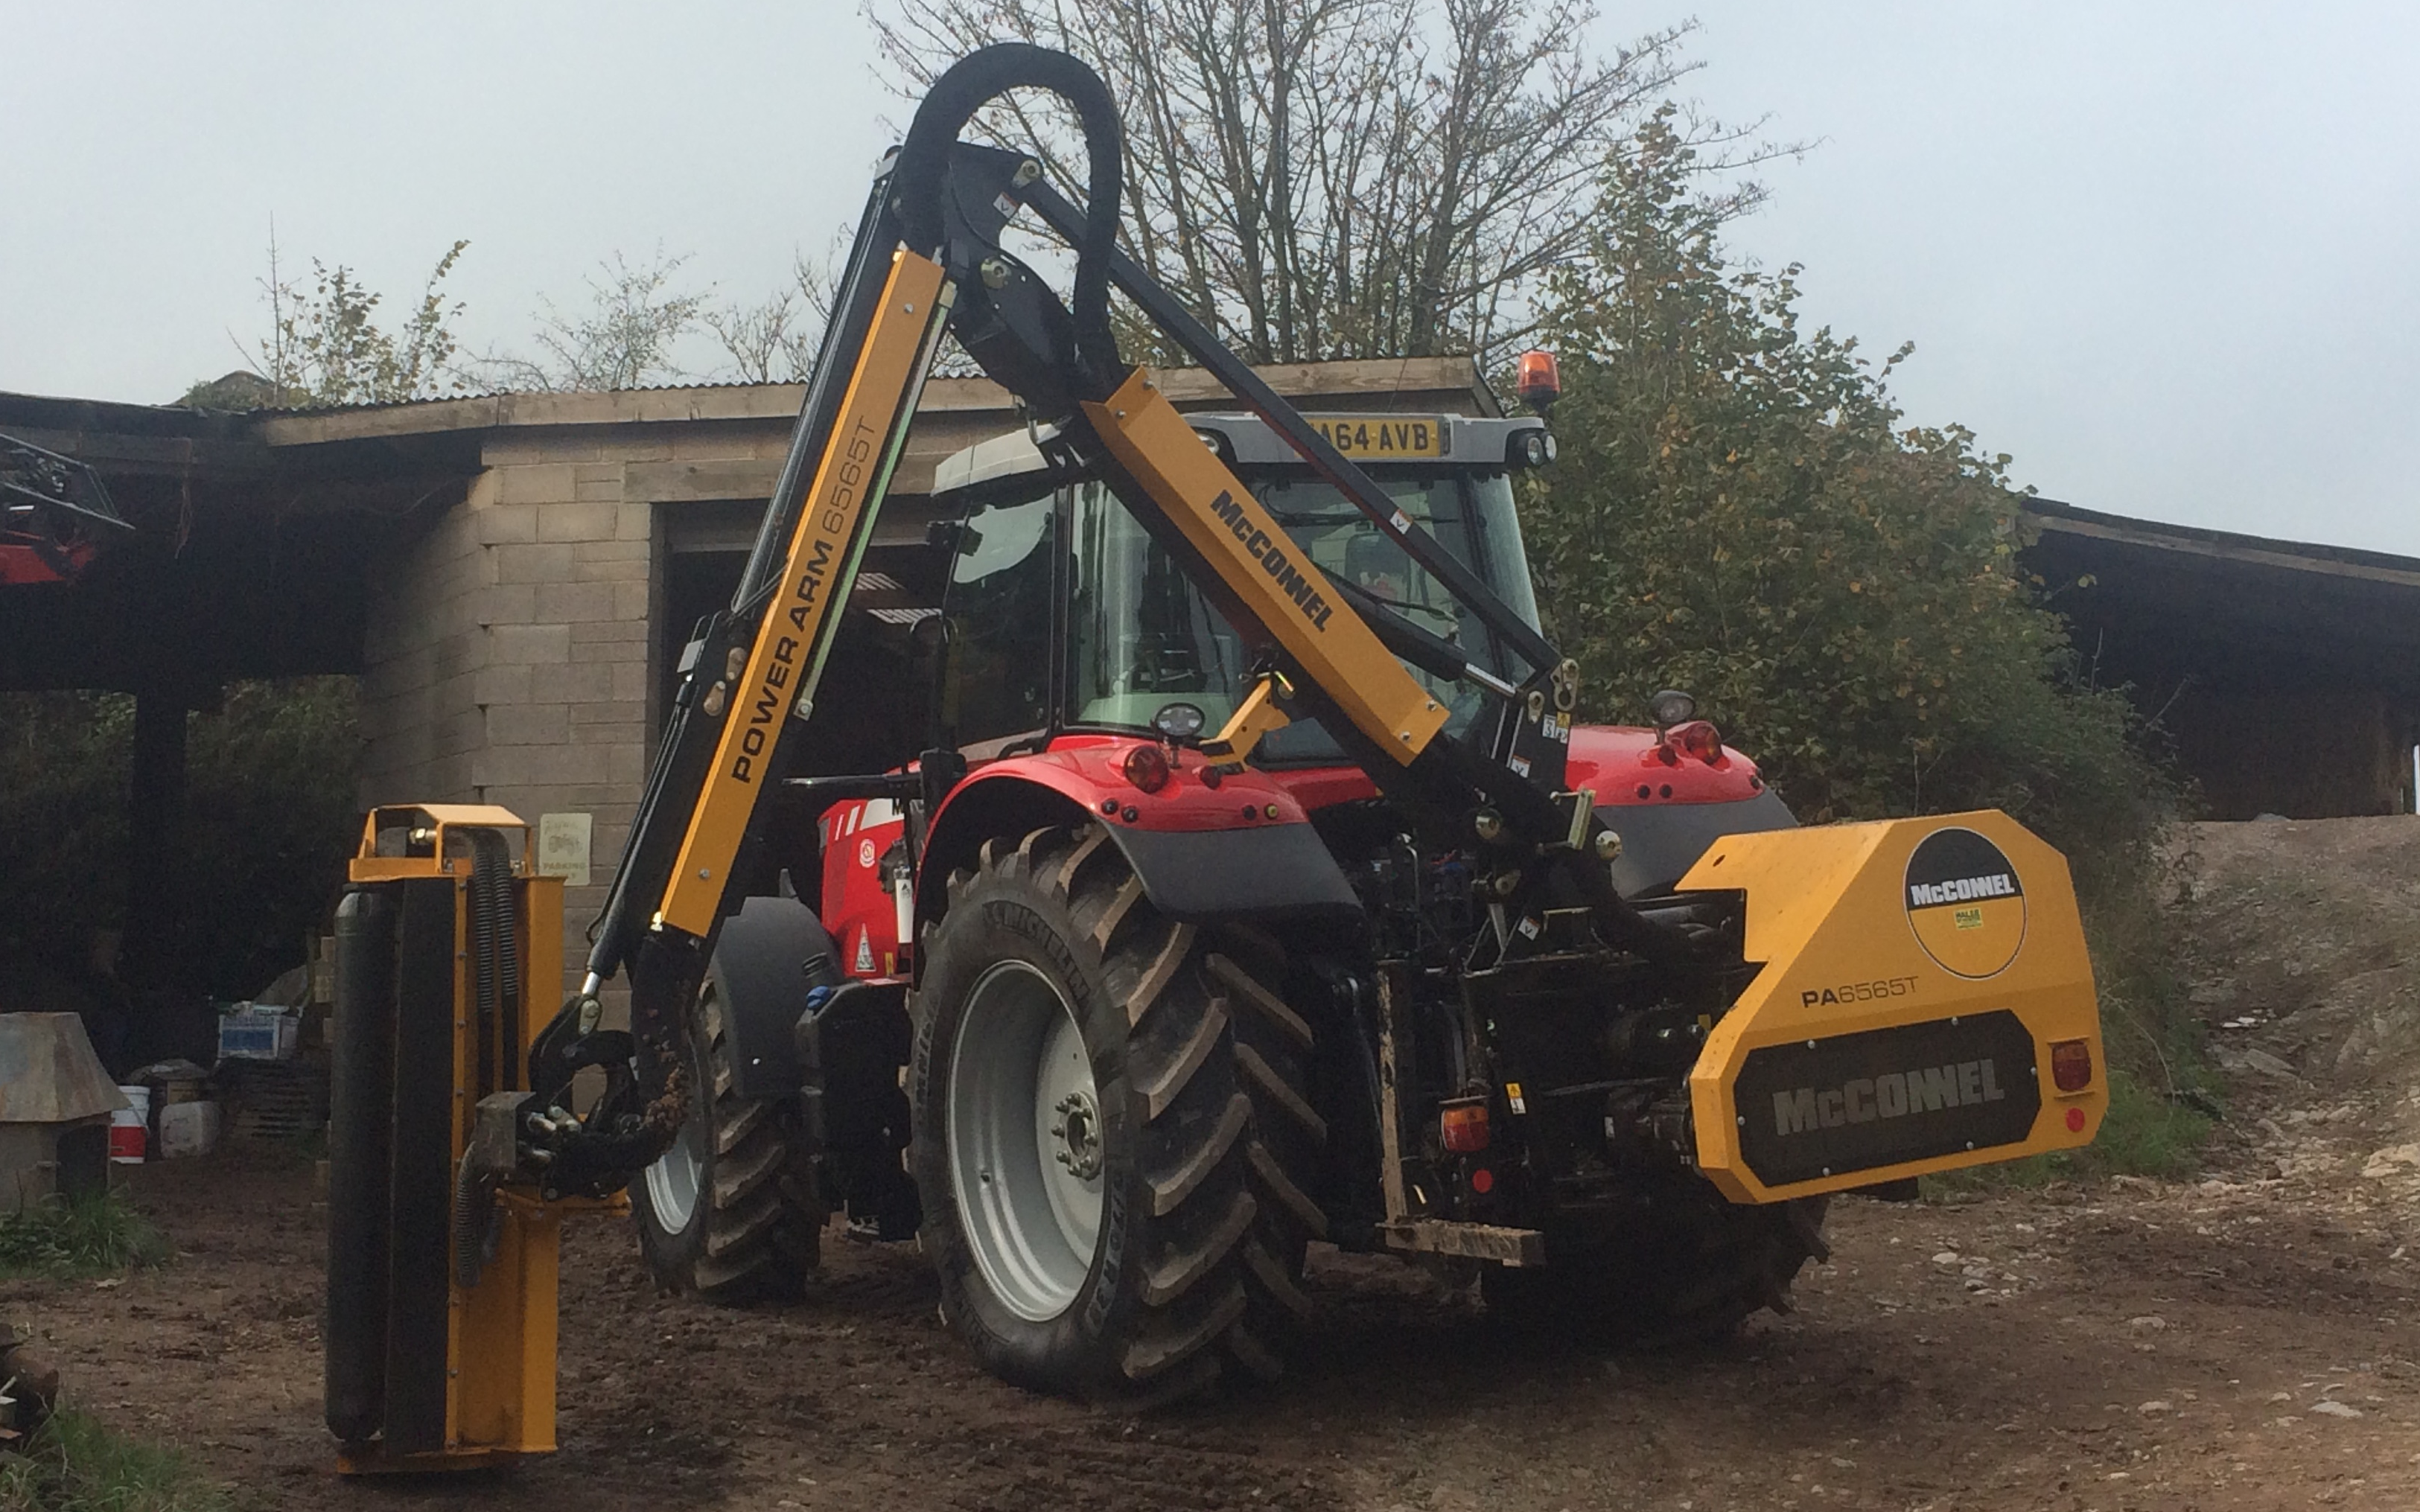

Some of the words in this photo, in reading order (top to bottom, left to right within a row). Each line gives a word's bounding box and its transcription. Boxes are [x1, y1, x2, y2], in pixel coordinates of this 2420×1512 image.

[1378, 424, 1429, 450] AVB
[732, 639, 800, 783] POWER
[789, 540, 833, 633] ARM
[822, 415, 875, 535] 6565T
[1910, 873, 2015, 905] McCONNEL
[1003, 902, 1090, 1000] MICHELIN
[1801, 975, 1920, 1009] PA6565T
[1772, 1059, 2005, 1135] McCONNEL
